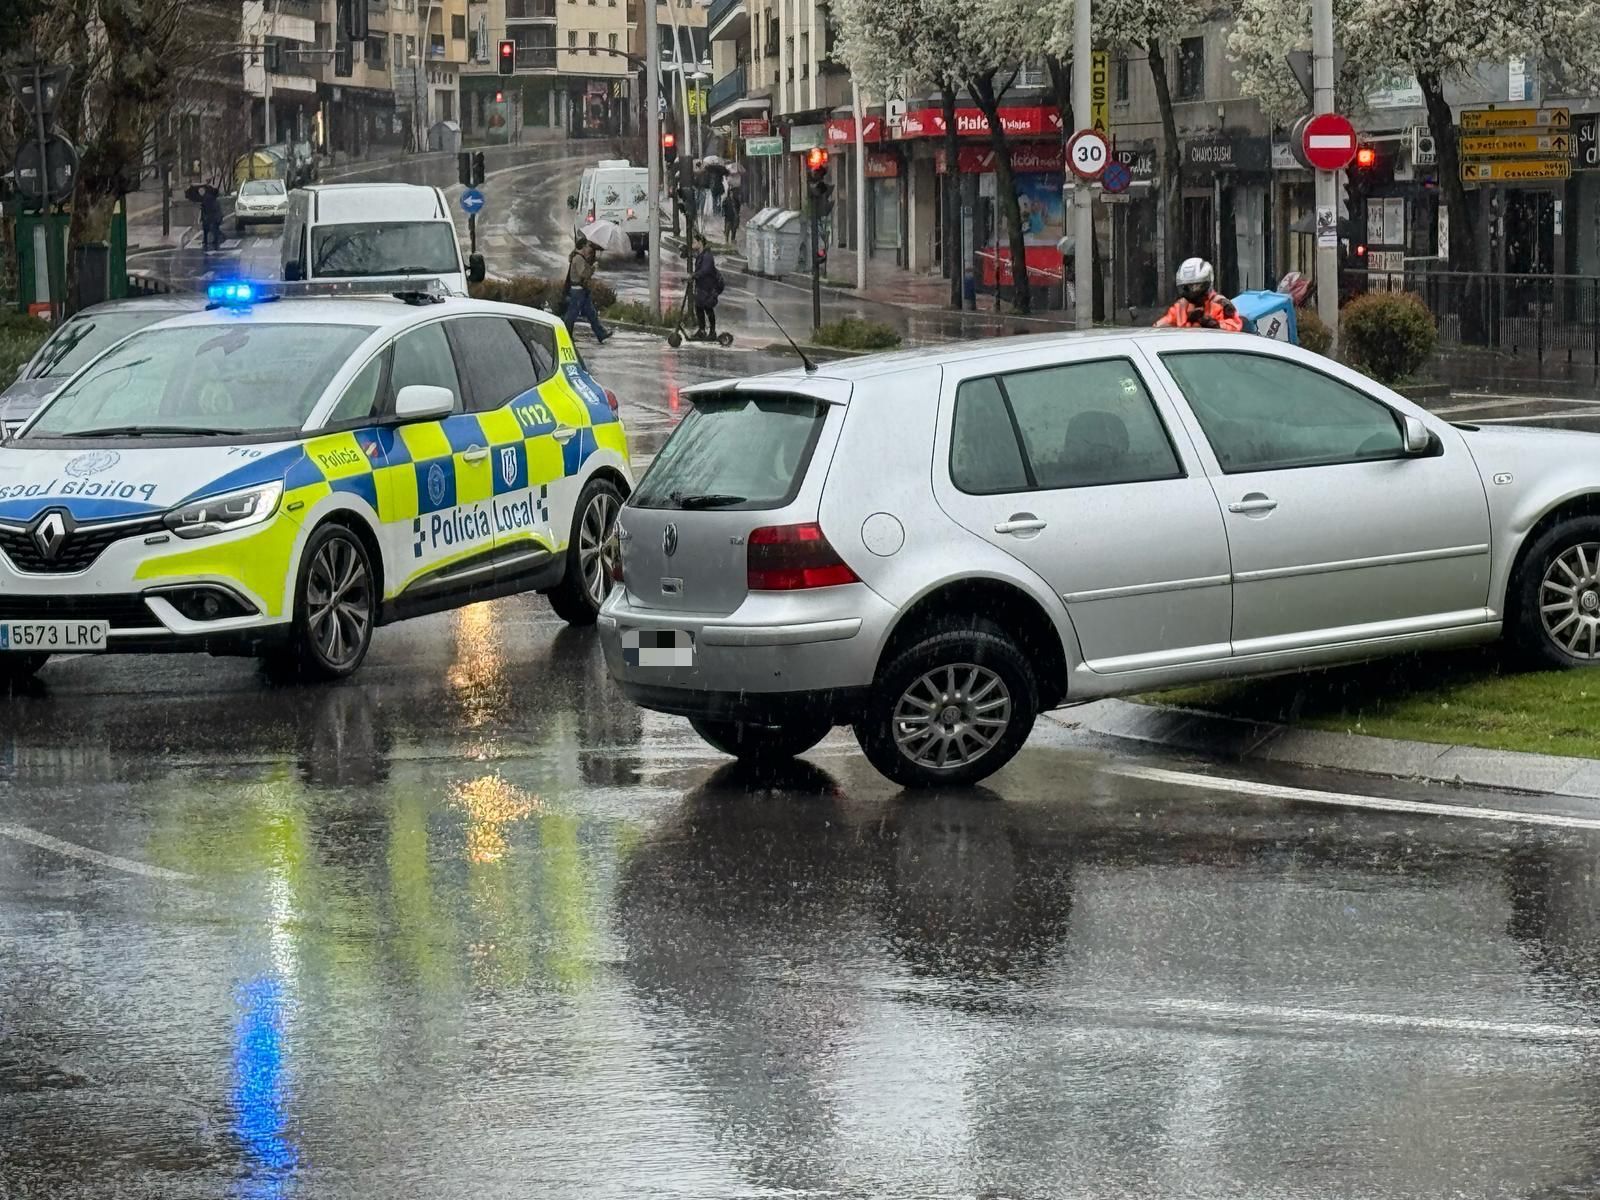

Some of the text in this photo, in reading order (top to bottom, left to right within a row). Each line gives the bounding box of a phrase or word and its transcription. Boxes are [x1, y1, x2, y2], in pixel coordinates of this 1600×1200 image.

[1092, 55, 1106, 132] HOSTA
[1077, 146, 1102, 162] 30
[431, 491, 535, 549] Policía Local
[12, 624, 103, 646] 5573 LRC
